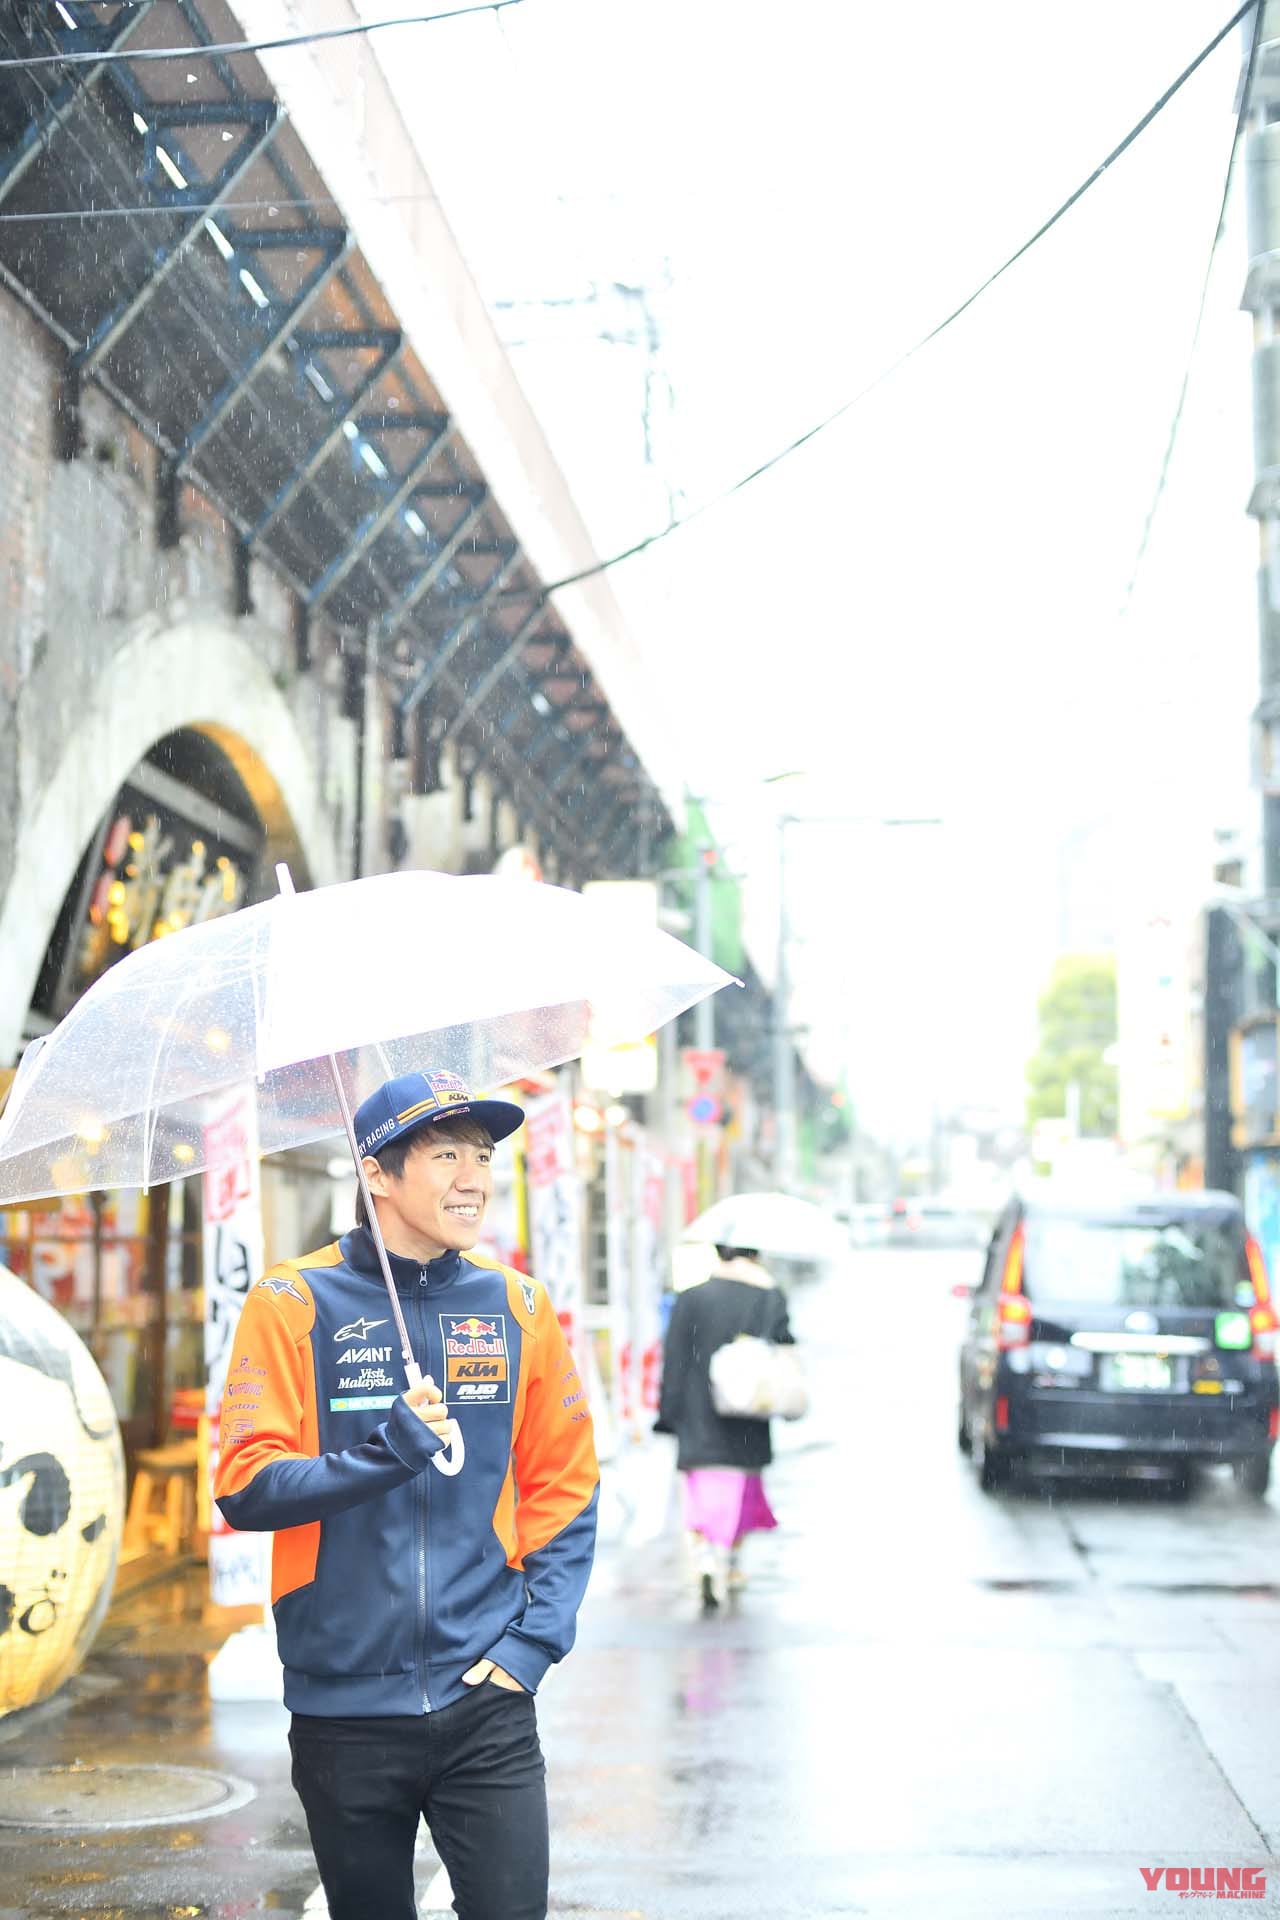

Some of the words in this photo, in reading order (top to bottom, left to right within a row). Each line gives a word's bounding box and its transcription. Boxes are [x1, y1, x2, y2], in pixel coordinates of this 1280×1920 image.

[366, 1118, 395, 1148] RACING
[336, 1347, 392, 1365] AVANT
[359, 1368, 385, 1379] Visit
[456, 1361, 498, 1377] KTM
[337, 1377, 394, 1391] Malaysia
